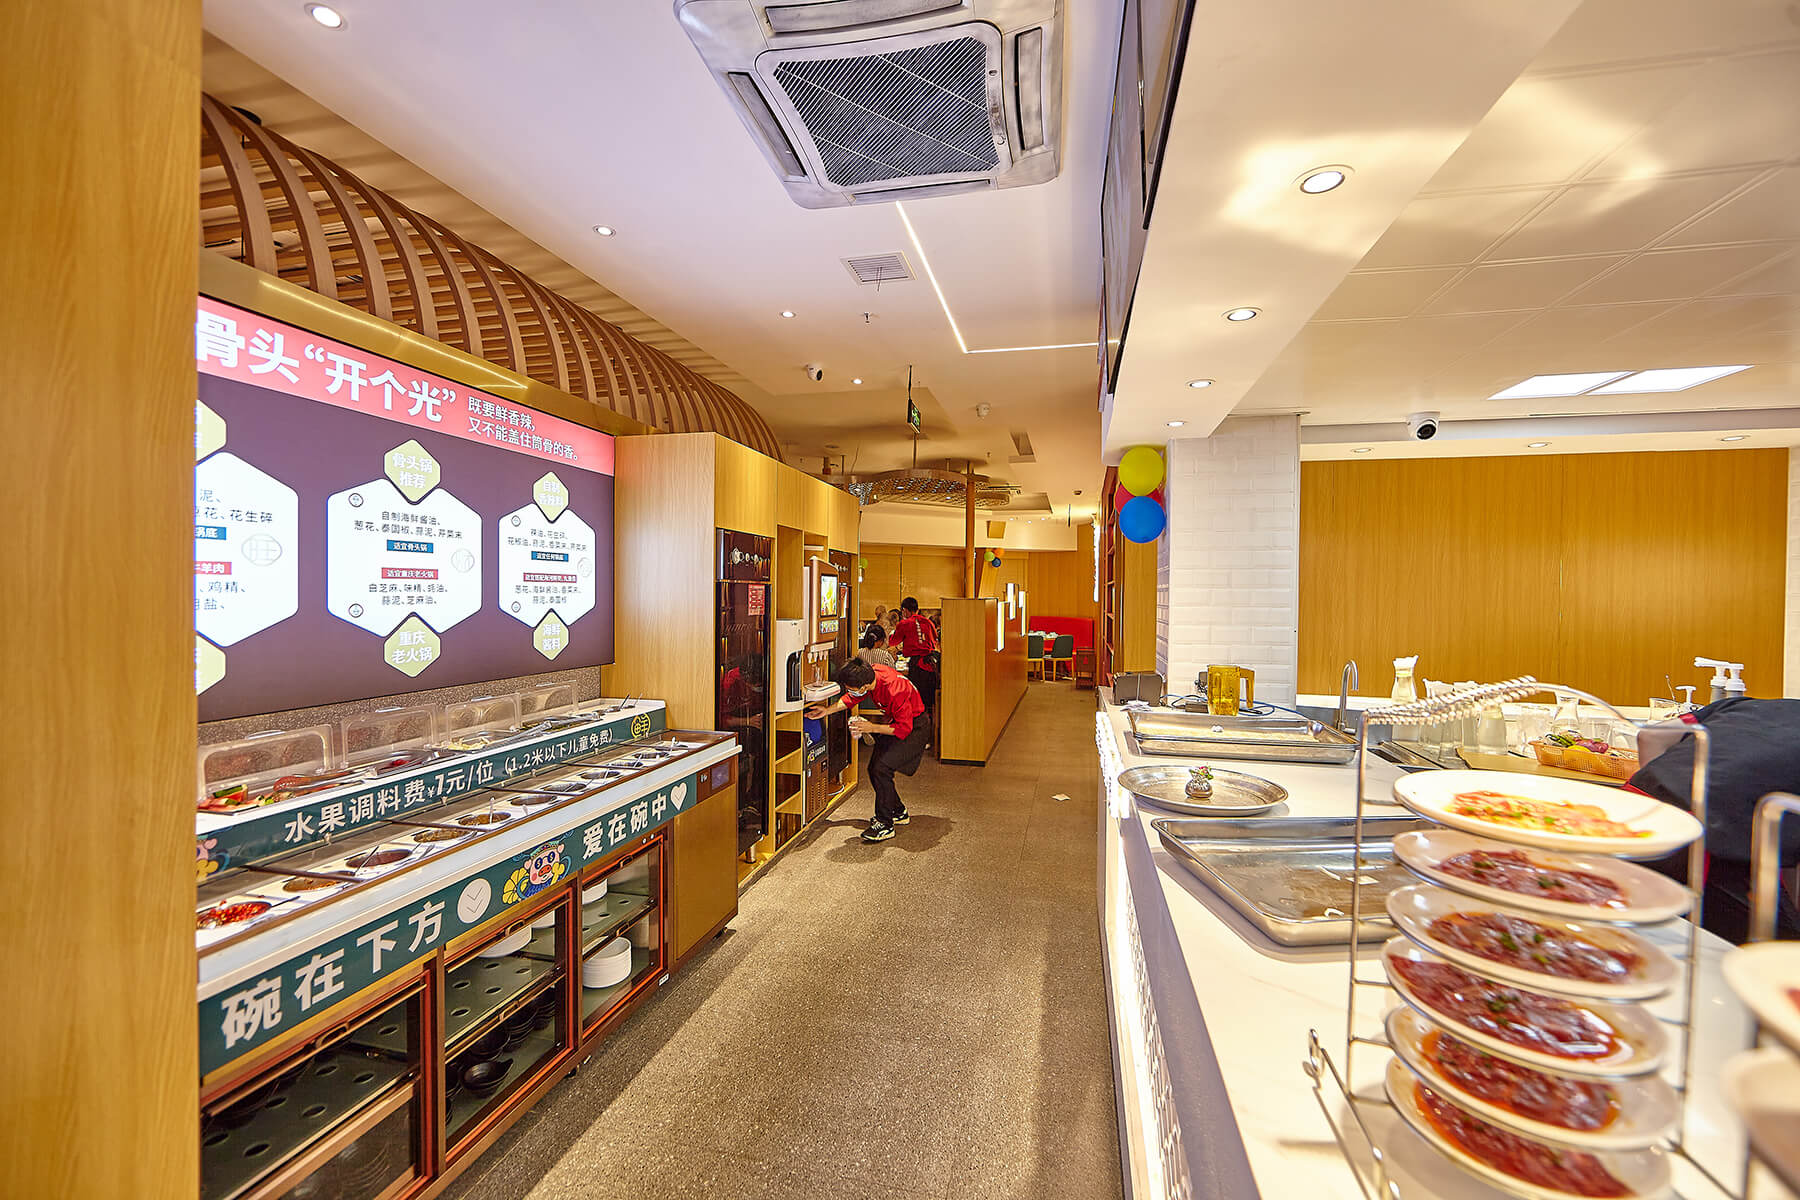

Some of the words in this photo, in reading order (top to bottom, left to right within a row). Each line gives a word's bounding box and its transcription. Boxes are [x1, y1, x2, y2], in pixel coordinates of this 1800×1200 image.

[468, 416, 578, 461] 又不能盖住筒骨的香。
[392, 453, 433, 473] 骨头锅
[399, 471, 426, 489] 推荐
[393, 542, 428, 552] 适宜骨头锅
[399, 631, 426, 646] 重庆
[392, 646, 433, 664] 老火锅
[582, 792, 667, 860] 爱在碗中
[221, 900, 446, 1050] 碗在下方
